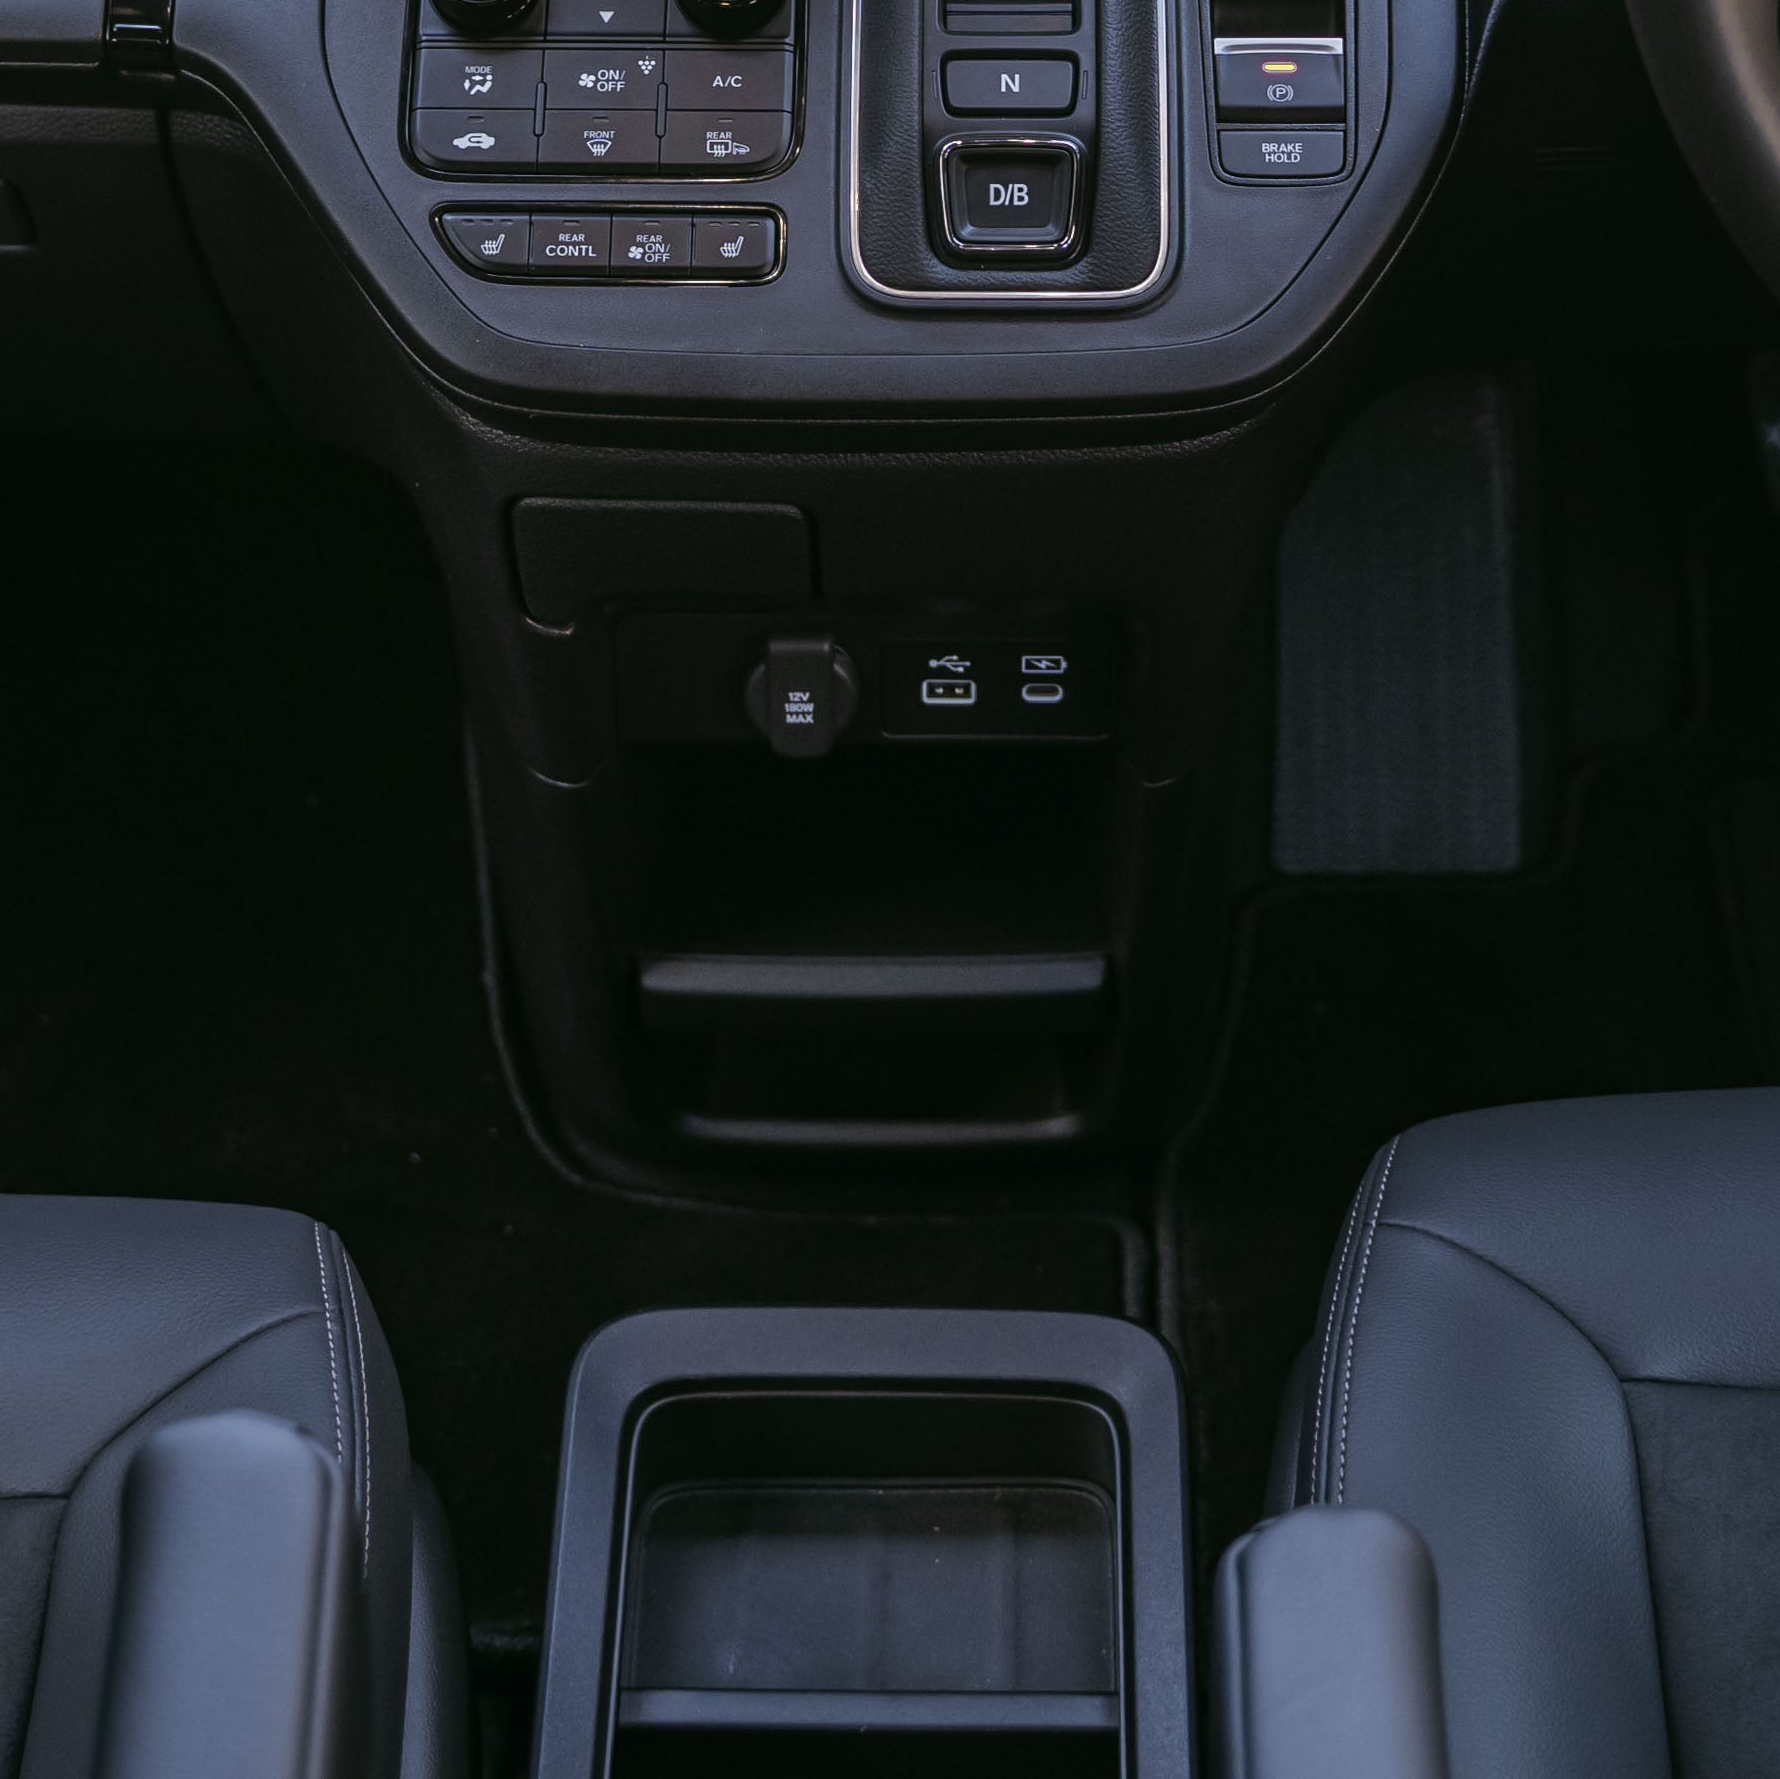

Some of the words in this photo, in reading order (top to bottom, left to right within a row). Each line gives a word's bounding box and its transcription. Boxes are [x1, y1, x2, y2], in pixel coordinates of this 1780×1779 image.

[465, 66, 492, 75] MODE
[597, 69, 625, 81] ON/
[712, 75, 743, 88] A/C
[1000, 73, 1020, 93] N
[597, 81, 626, 93] OFF
[584, 130, 616, 140] FRONT
[707, 131, 732, 140] REAR
[1262, 142, 1303, 154] BRAKE
[1265, 152, 1301, 164] HOLD
[989, 183, 1029, 206] D/B
[559, 233, 585, 242] REAR
[637, 234, 663, 243] REAR
[545, 244, 597, 257] CONTL
[645, 242, 671, 253] ON/
[645, 253, 670, 263] OFF
[788, 692, 809, 701] 12V
[784, 703, 814, 712] 180W
[786, 713, 814, 723] MAX
